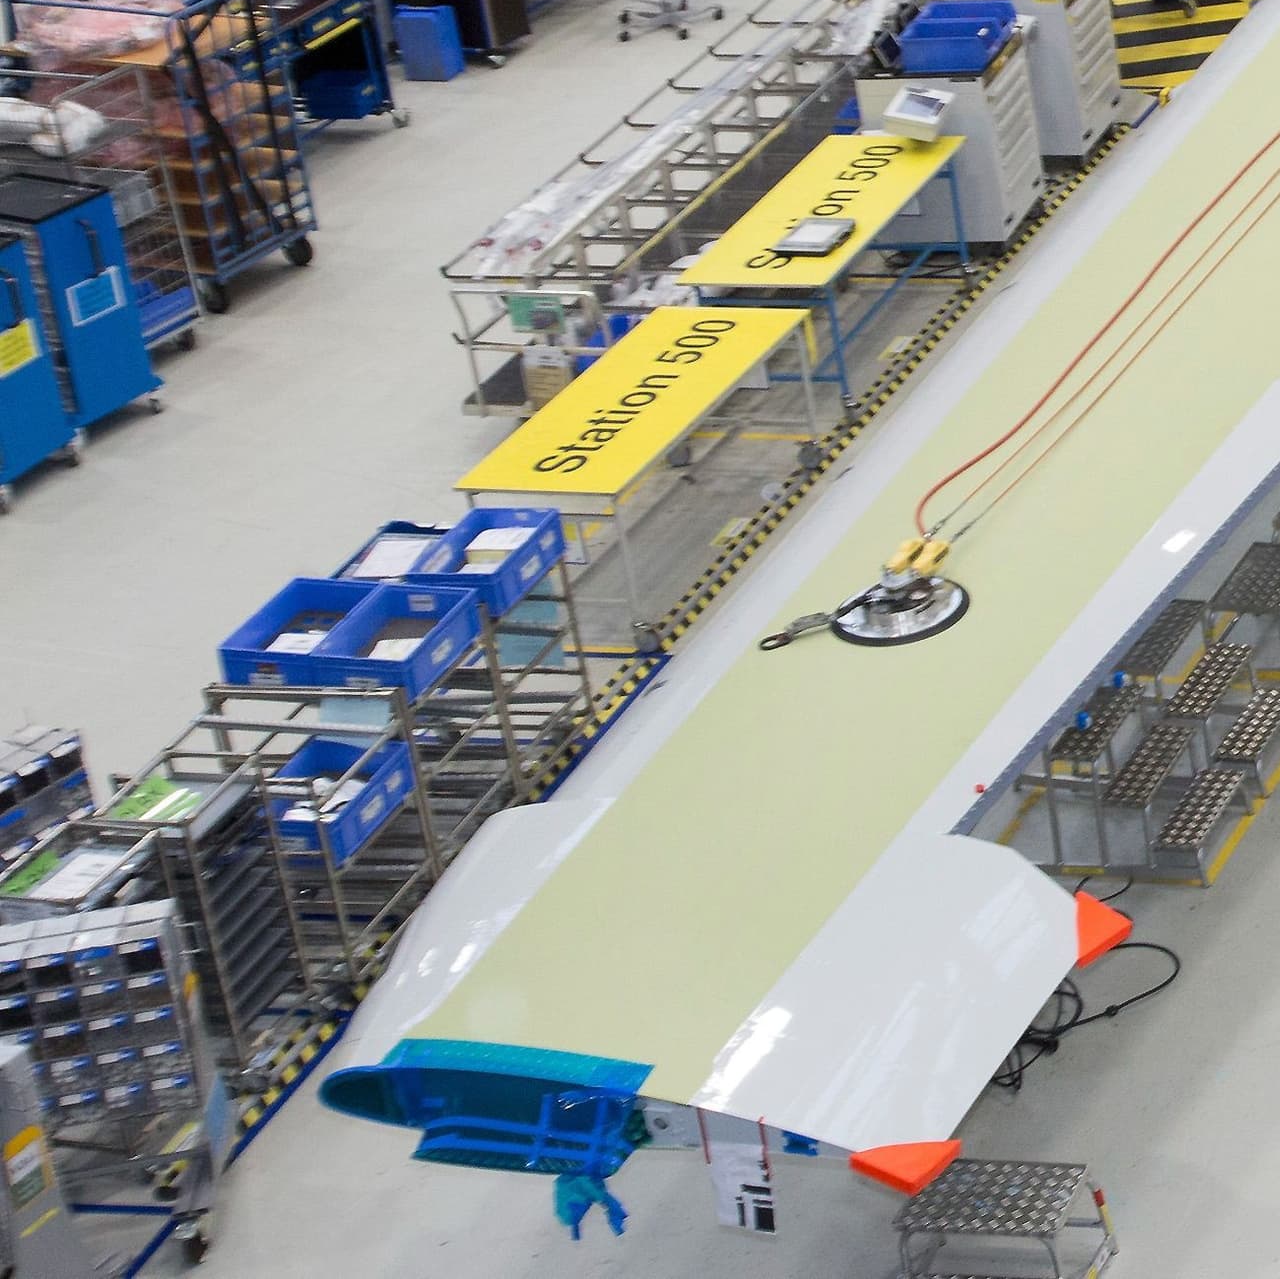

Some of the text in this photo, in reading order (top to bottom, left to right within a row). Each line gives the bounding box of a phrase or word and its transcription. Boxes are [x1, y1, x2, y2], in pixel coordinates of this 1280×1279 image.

[836, 145, 904, 181] 500
[533, 319, 737, 473] Station 500
